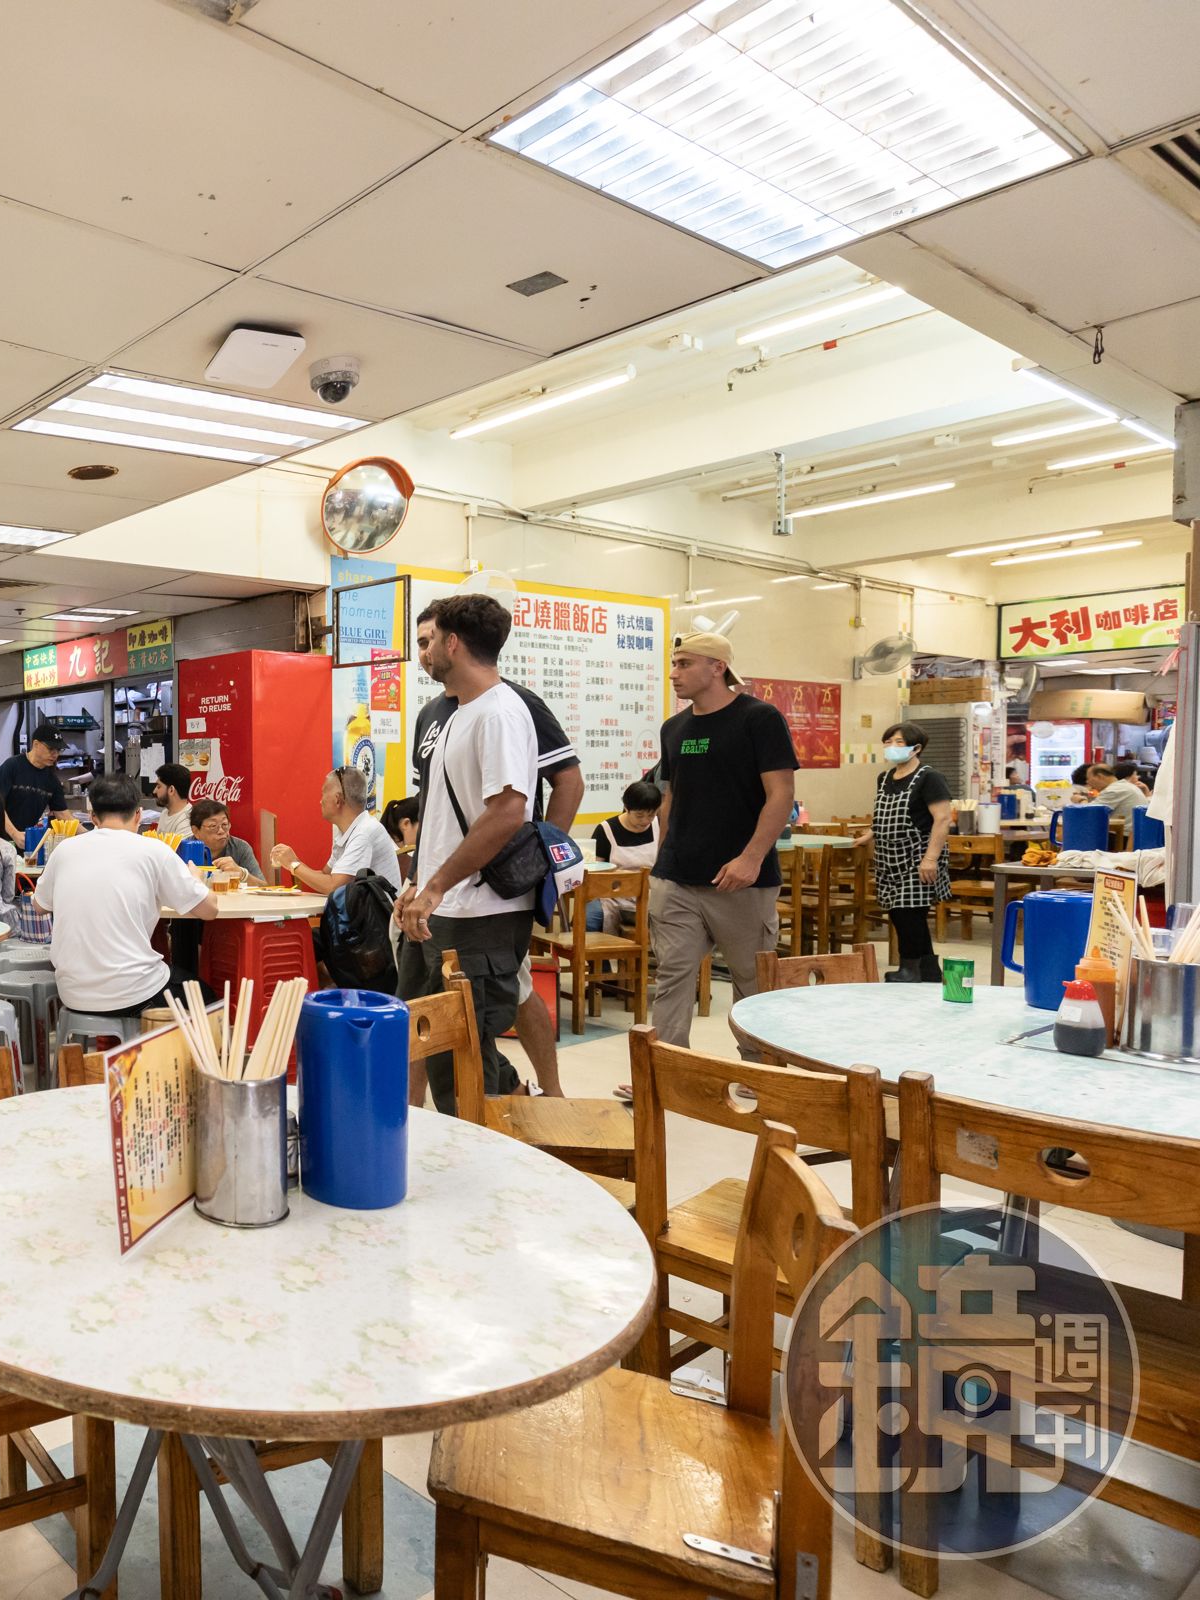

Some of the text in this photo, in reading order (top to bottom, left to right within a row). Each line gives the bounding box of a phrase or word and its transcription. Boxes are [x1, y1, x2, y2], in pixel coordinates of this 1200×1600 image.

[513, 597, 607, 634] 記燒臘飯店
[617, 614, 654, 632] 特式燒臘
[340, 626, 386, 640] BLUE GIRL
[1009, 599, 1178, 653] 大利咖啡店
[128, 624, 168, 648] 即磨咖啡
[25, 651, 56, 666] 中西快餐
[68, 640, 114, 677] 九記
[129, 648, 169, 669] 香滑奶茶
[25, 670, 56, 688] 精美小炒
[201, 695, 229, 705] RETURN
[209, 703, 232, 712] REUSE
